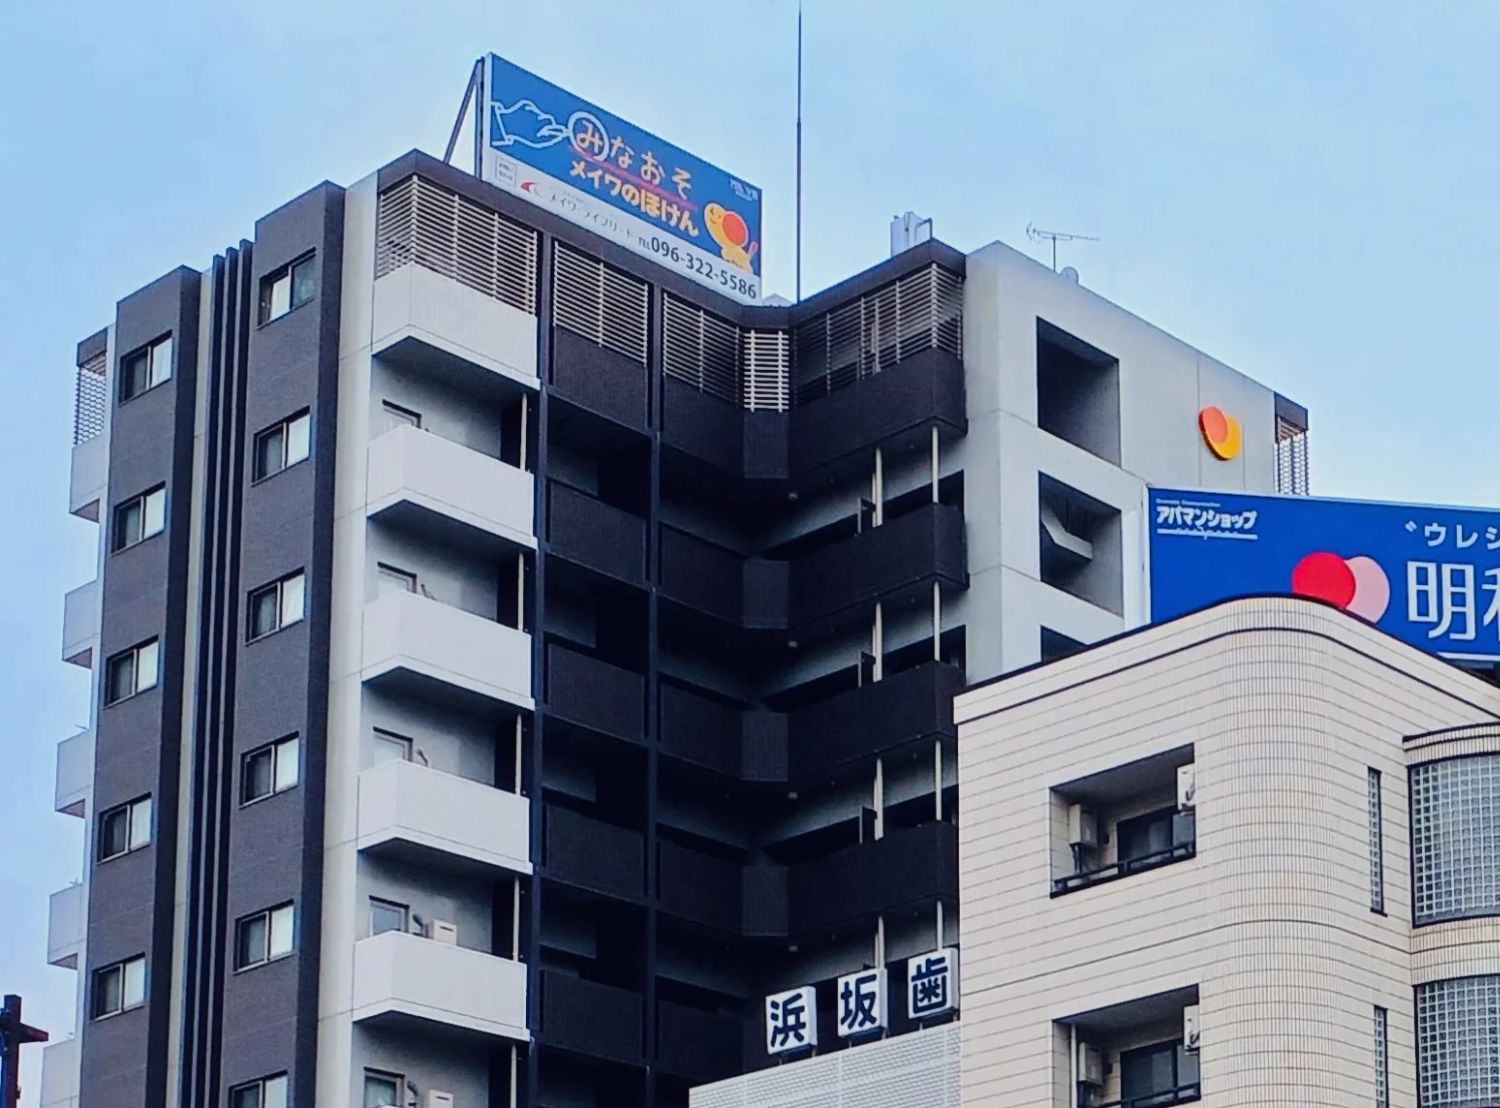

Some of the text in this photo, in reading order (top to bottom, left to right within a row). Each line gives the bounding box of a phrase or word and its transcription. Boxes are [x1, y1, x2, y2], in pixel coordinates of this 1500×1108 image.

[570, 161, 699, 237] メイワのほけん
[652, 236, 757, 299] 096-322-5586
[1156, 505, 1257, 530] アパマンショップ
[770, 956, 949, 1048] 浜坂歯
